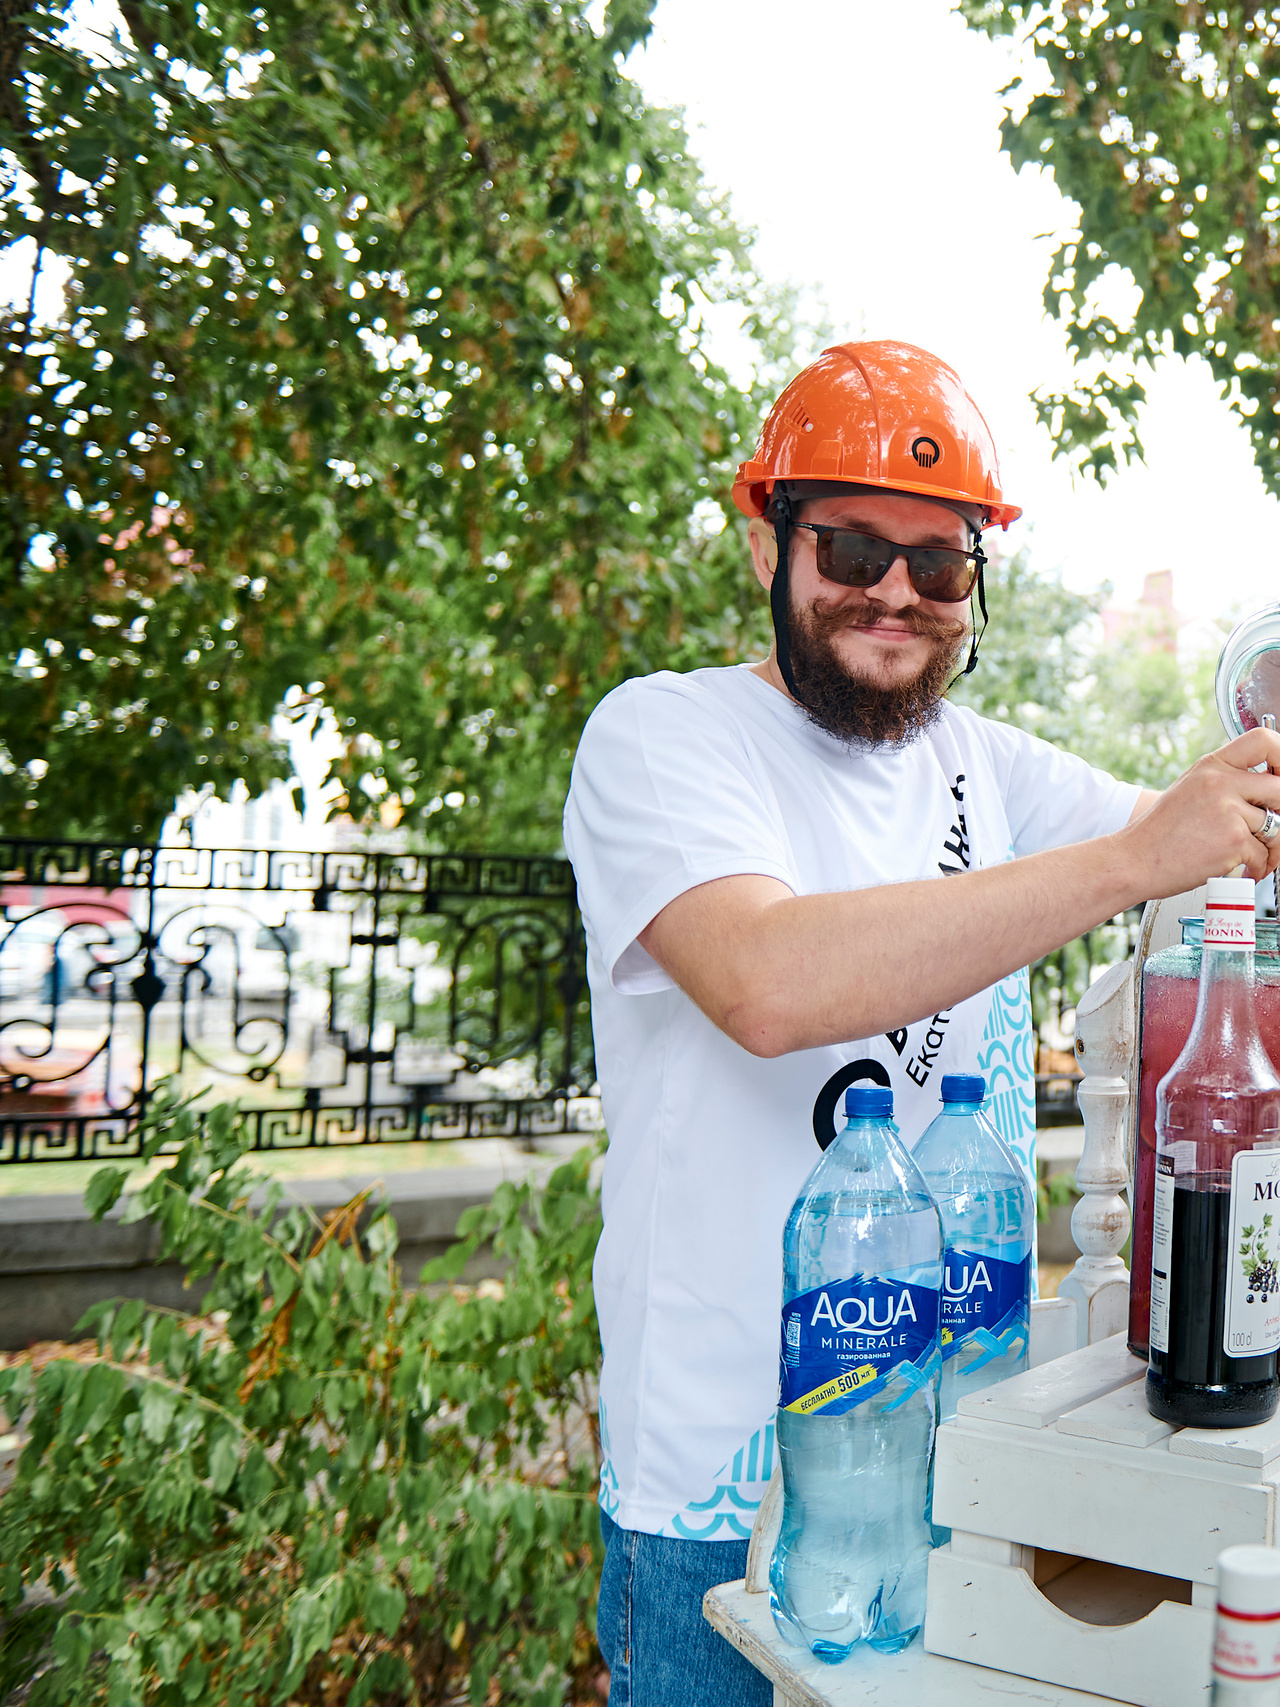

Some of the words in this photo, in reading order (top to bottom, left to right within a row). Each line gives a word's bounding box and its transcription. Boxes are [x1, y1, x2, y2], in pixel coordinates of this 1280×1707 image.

[1205, 928, 1244, 937] MONIN
[905, 1006, 953, 1088] Екат
[943, 1260, 993, 1302] UA
[810, 1289, 918, 1336] AQUA
[943, 1302, 982, 1314] RALE
[821, 1333, 908, 1350] MINERALE
[1232, 1332, 1245, 1347] 100
[836, 1352, 891, 1362] газированная
[800, 1385, 836, 1411] БЕСПЛАТНО
[837, 1371, 860, 1392] 500
